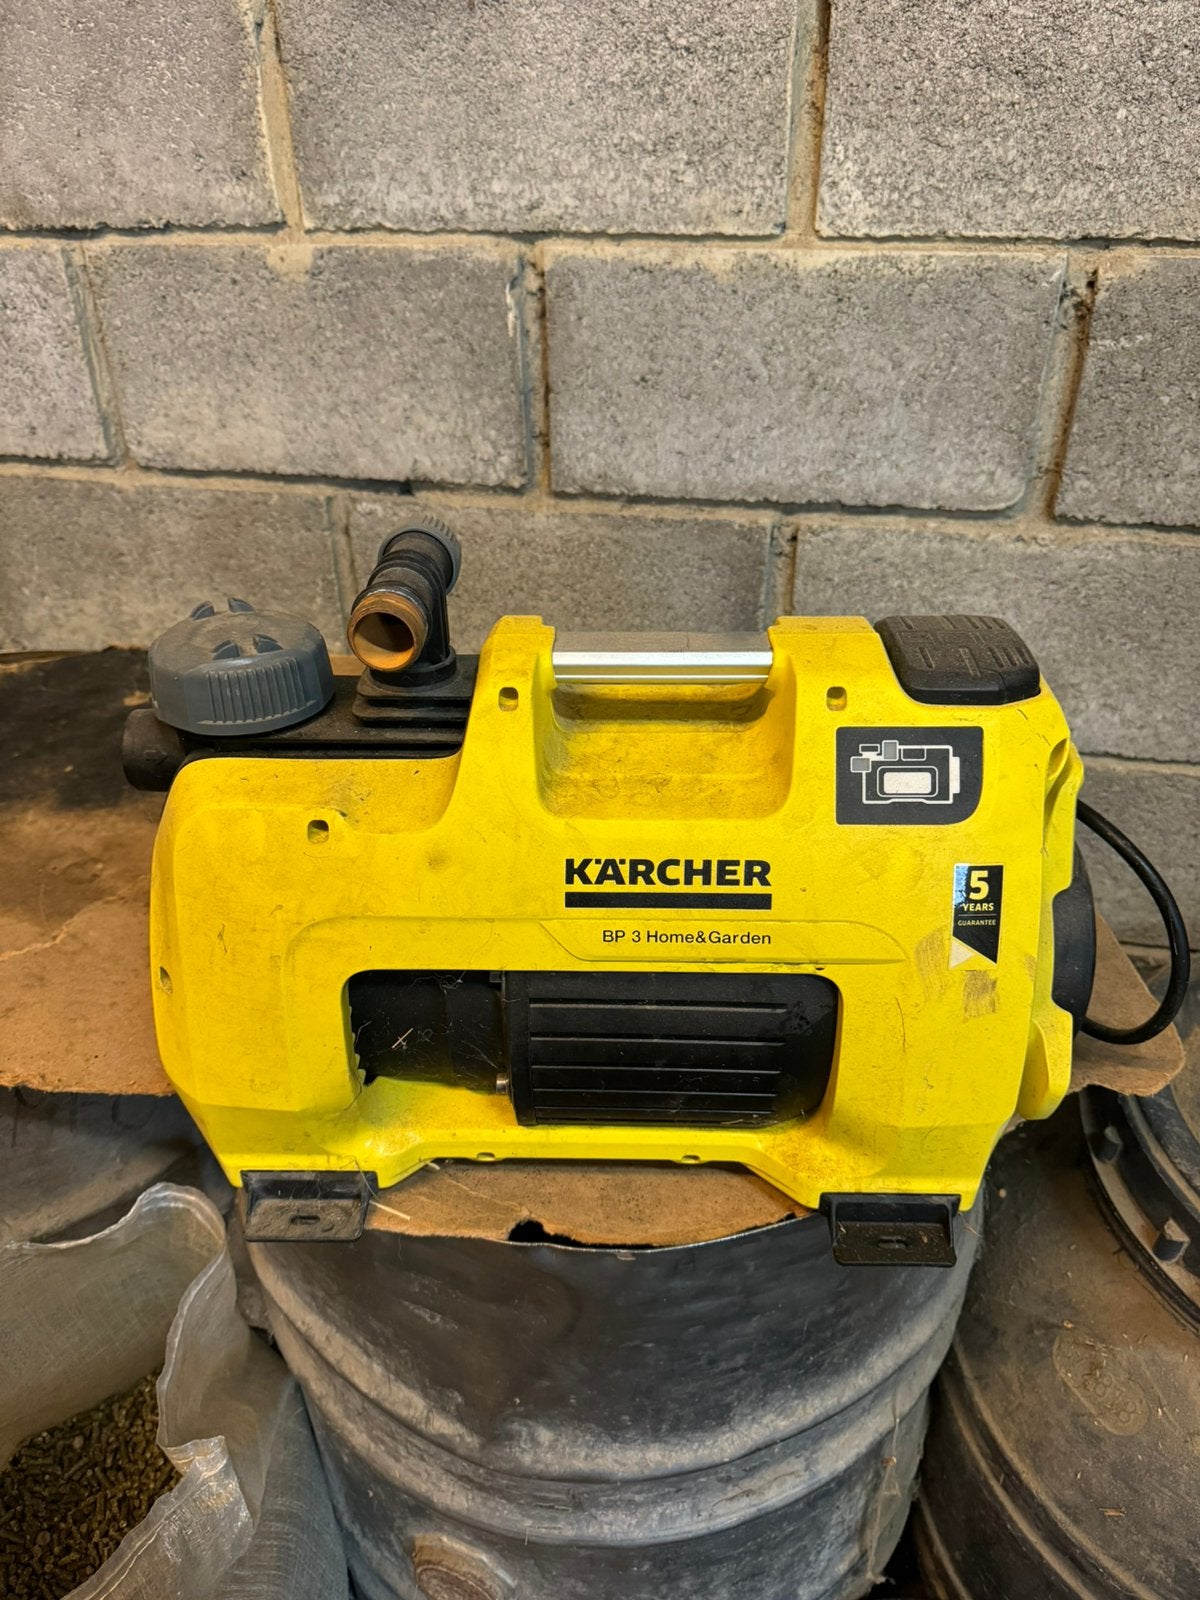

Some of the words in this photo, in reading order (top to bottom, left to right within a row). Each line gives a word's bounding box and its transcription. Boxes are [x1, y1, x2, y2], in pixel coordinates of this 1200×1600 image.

[565, 858, 772, 886] KÄRCHER
[969, 870, 989, 900] 5
[961, 902, 994, 912] YEARS
[602, 930, 626, 943] BP
[631, 930, 641, 943] 3
[646, 930, 772, 945] Home&Garden
